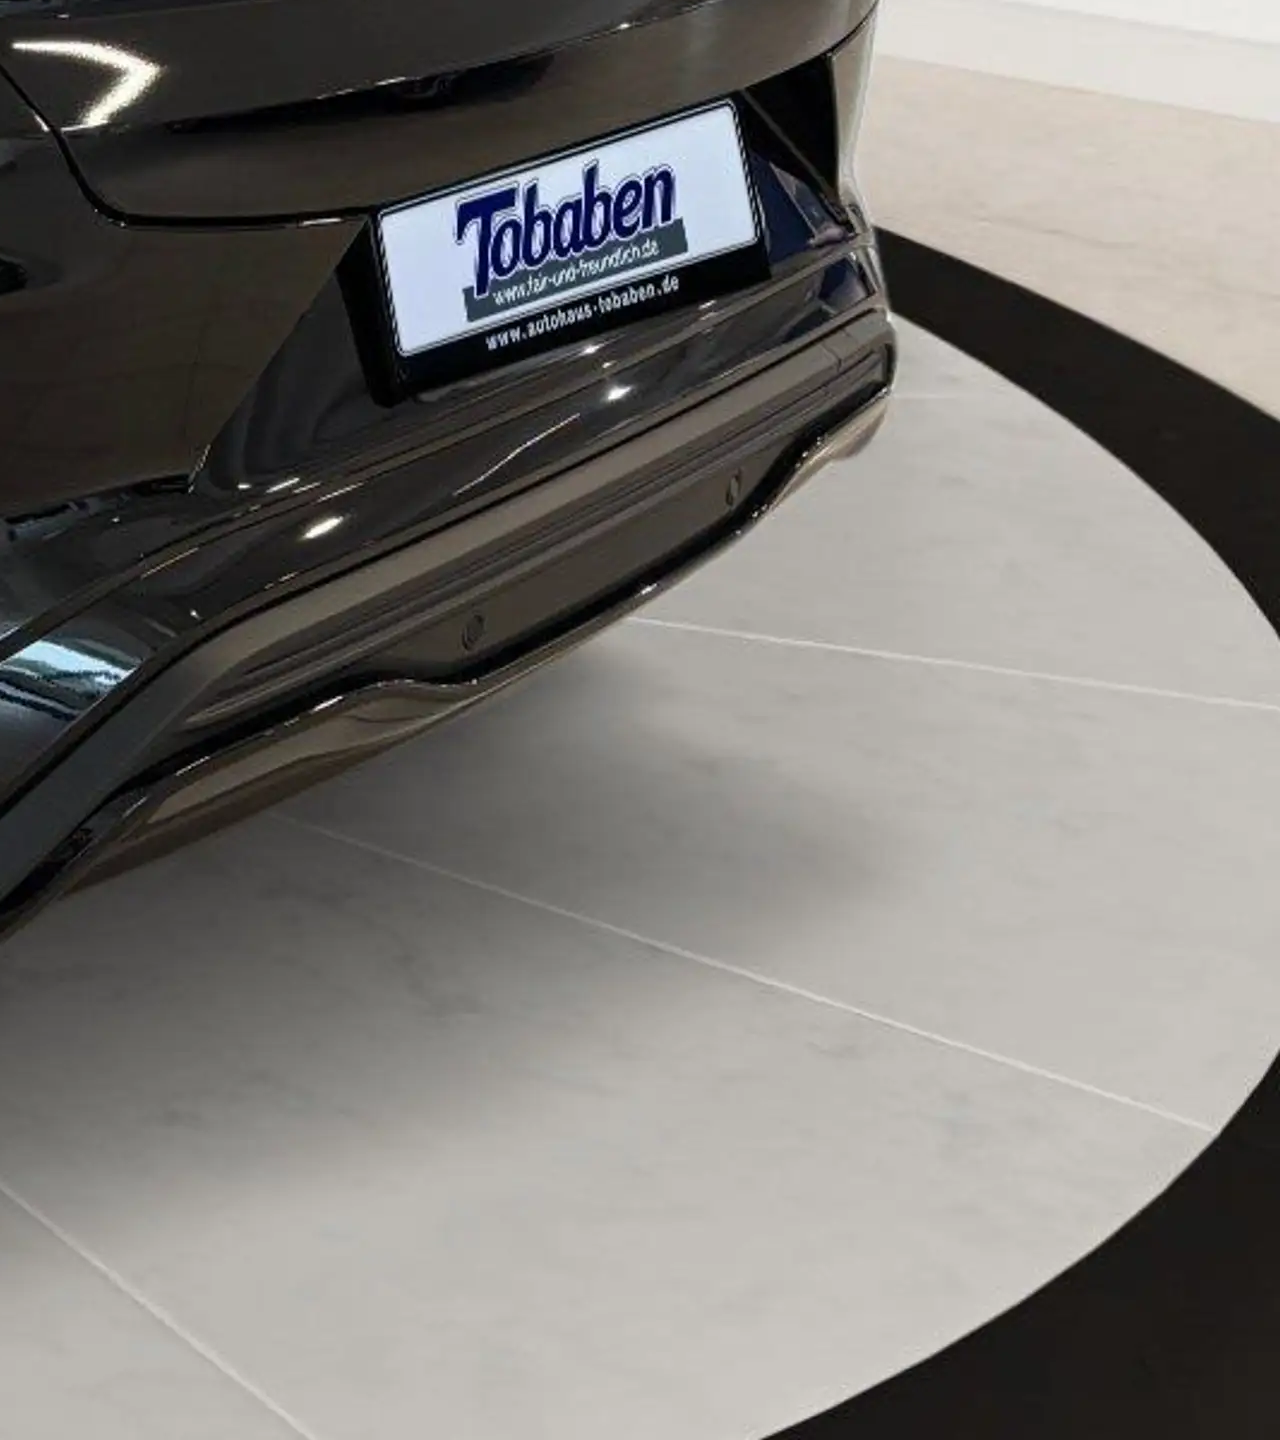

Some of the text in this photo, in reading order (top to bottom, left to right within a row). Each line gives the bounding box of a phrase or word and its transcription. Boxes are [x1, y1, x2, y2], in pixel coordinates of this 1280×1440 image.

[456, 160, 675, 298] Tobaben
[493, 239, 660, 306] www.fair-und-freundlich.de
[485, 275, 680, 351] www.autohaus-tobaben.de
